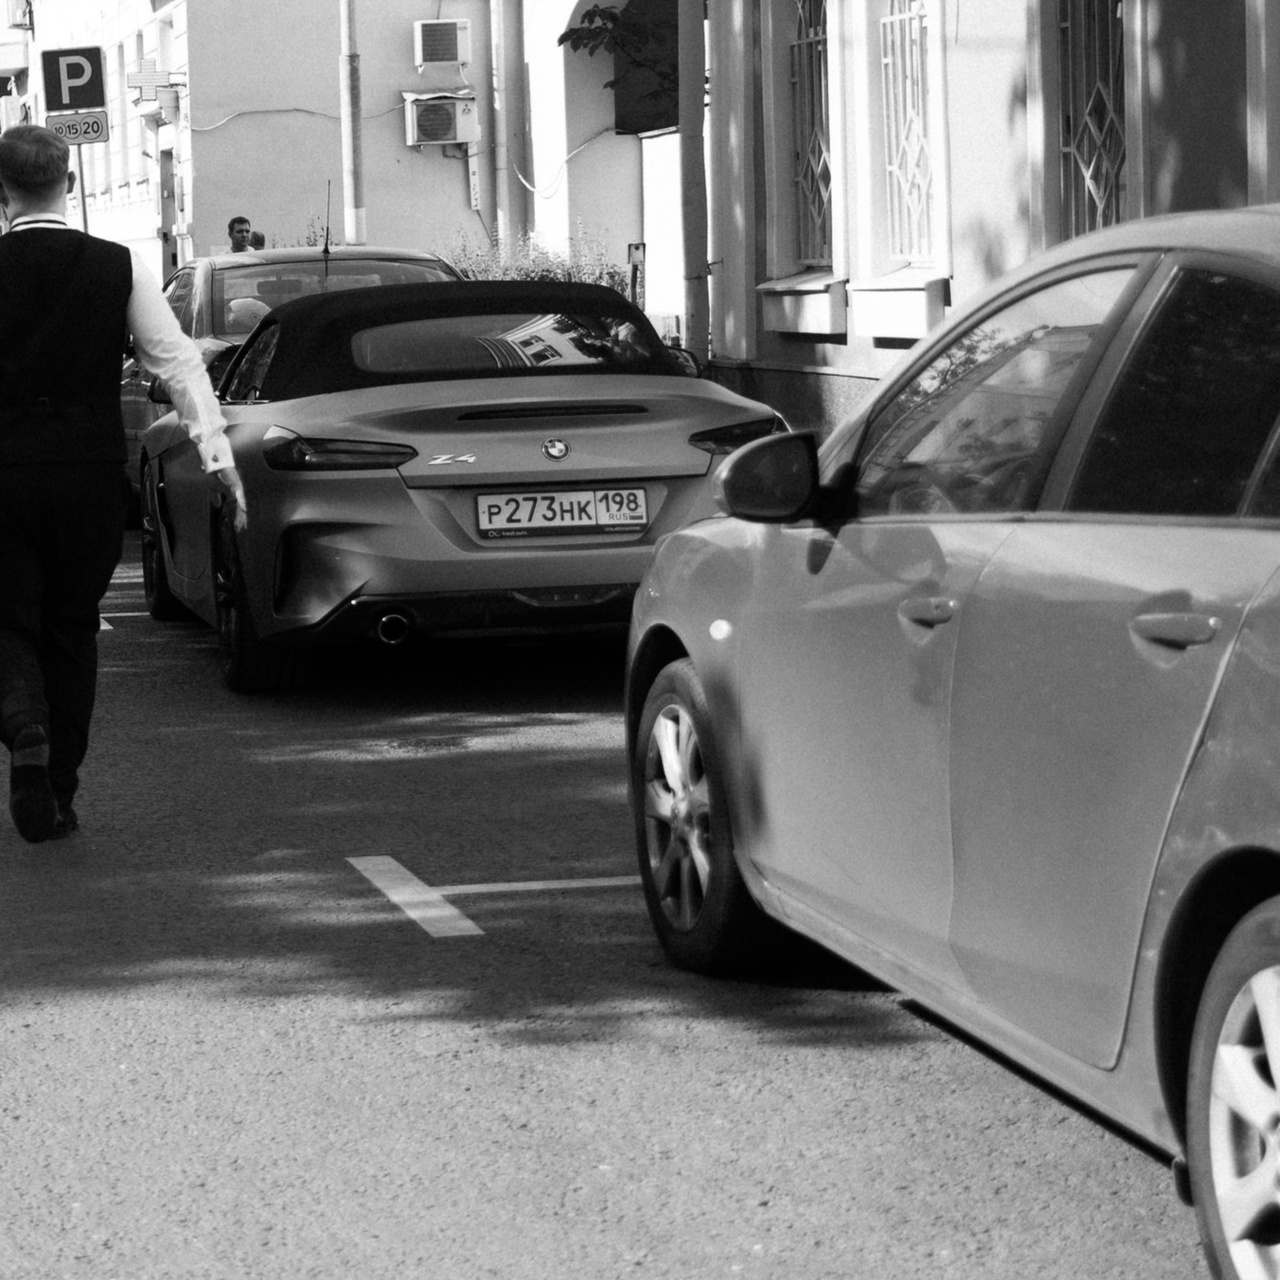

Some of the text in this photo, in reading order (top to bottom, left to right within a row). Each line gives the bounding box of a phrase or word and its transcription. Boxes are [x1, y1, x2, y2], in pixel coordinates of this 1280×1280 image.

[59, 55, 93, 105] P
[54, 121, 100, 136] 10 15 20
[428, 453, 477, 466] Z4
[598, 492, 639, 513] 198
[608, 512, 628, 521] RUS
